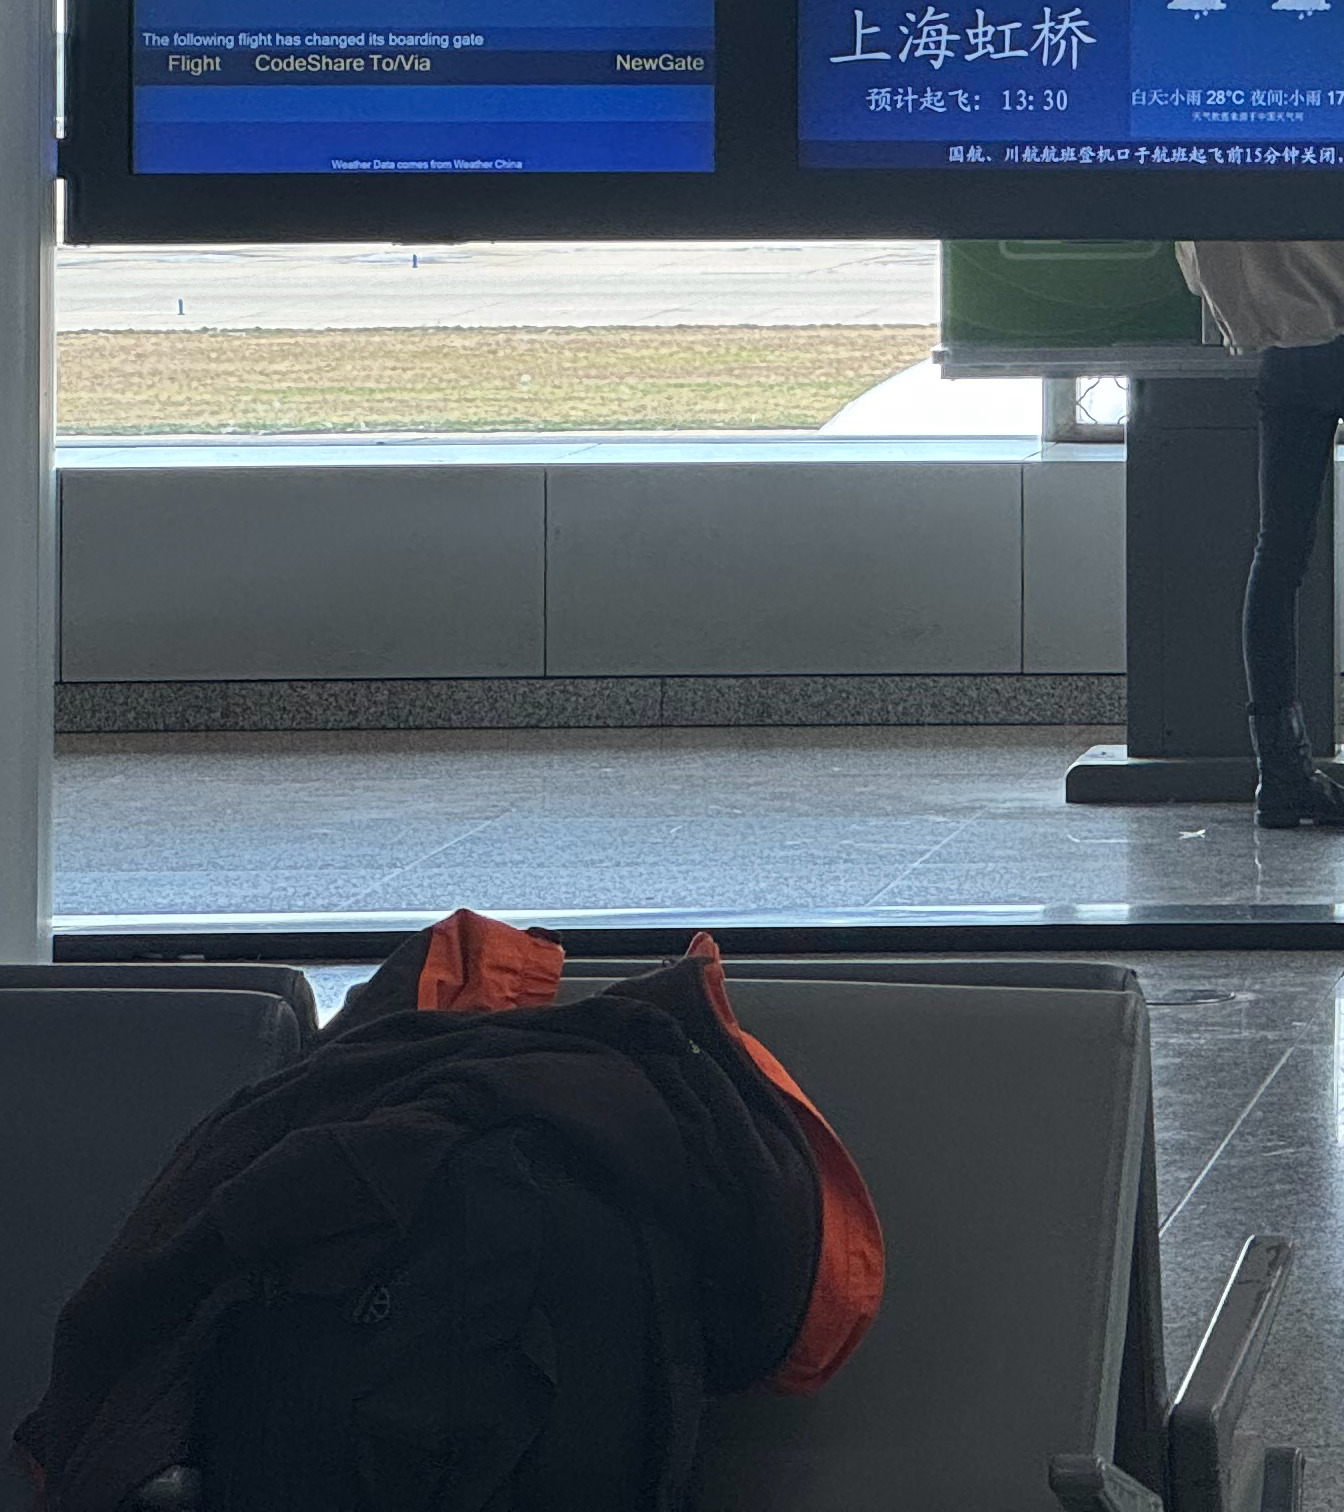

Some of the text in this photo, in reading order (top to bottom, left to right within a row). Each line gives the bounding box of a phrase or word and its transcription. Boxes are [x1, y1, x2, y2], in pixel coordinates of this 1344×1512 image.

[143, 33, 484, 49] The following flight has changed its boarding gate
[830, 6, 1097, 70] 上海虹桥
[168, 54, 704, 76] Flight CodeShare To/Via NewGate
